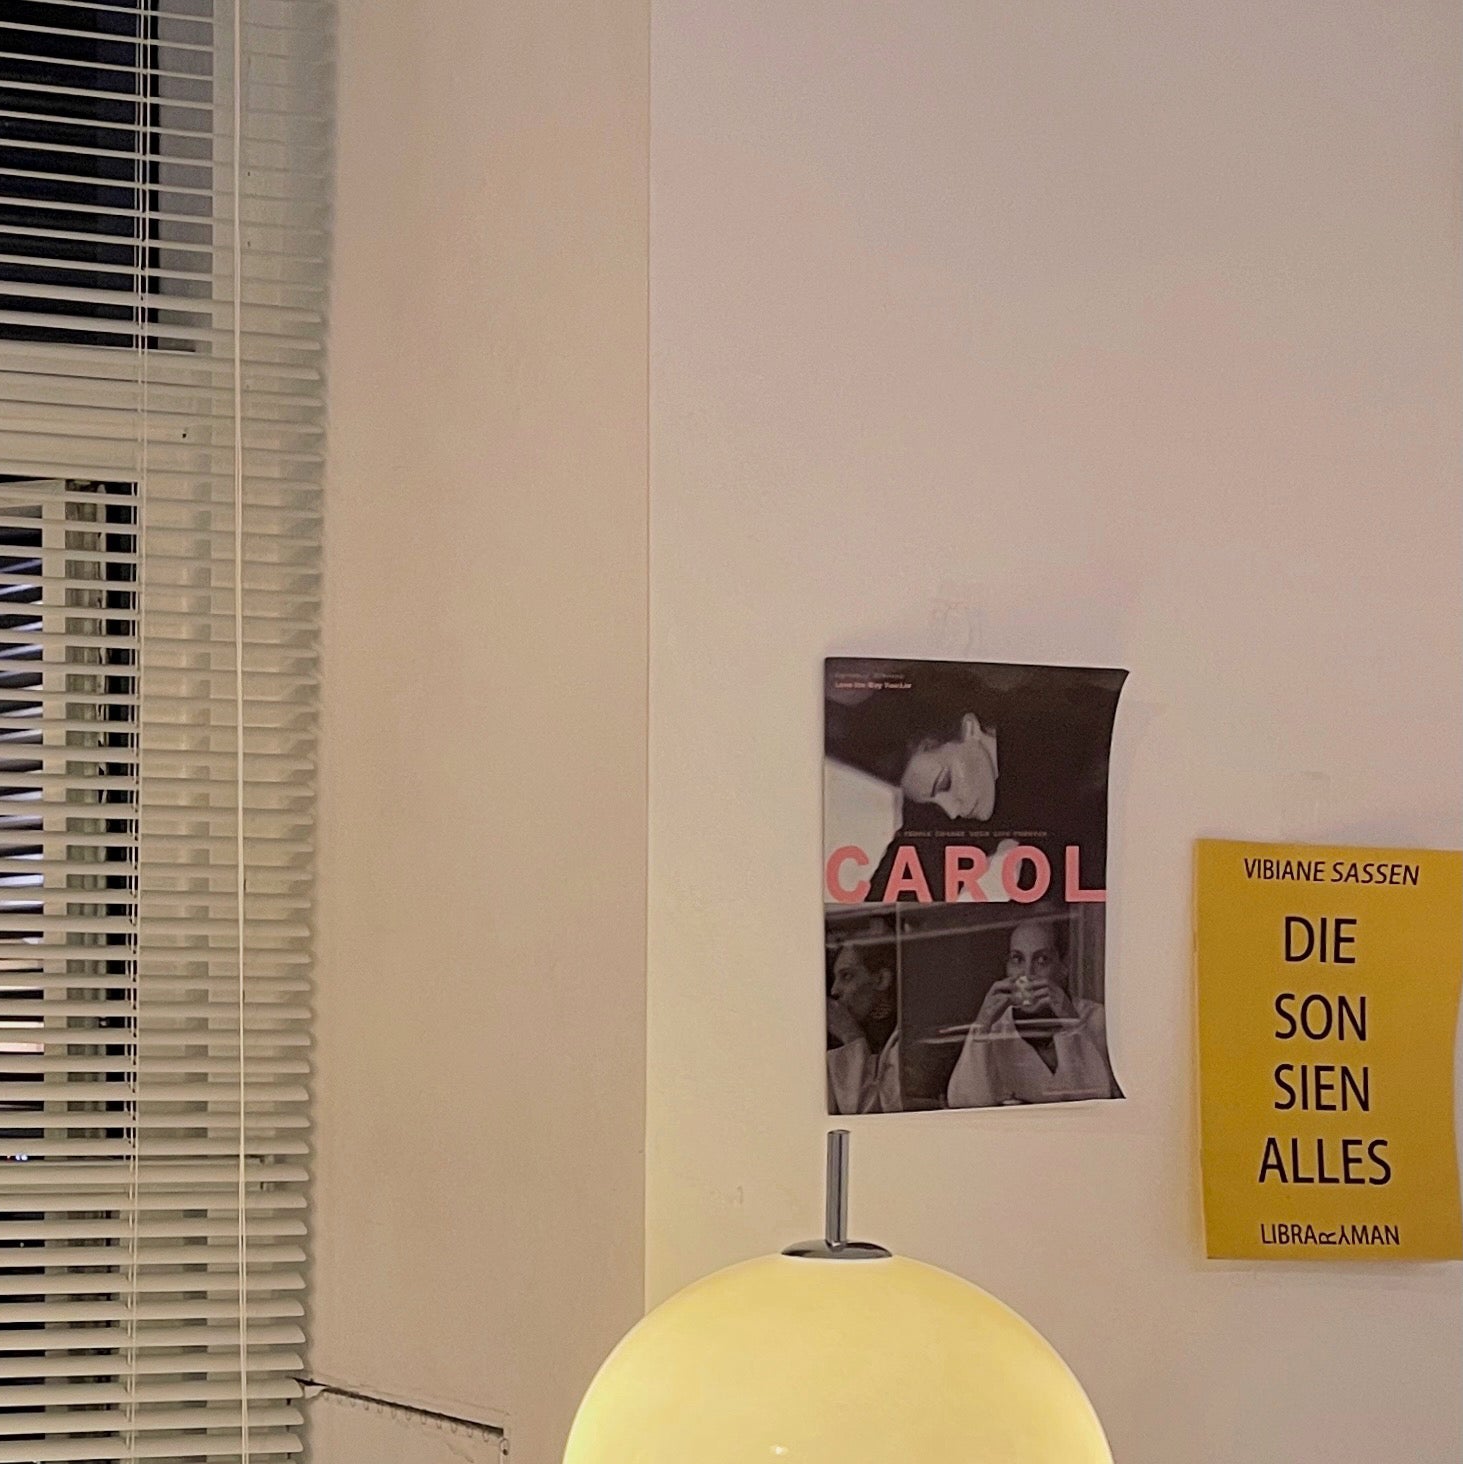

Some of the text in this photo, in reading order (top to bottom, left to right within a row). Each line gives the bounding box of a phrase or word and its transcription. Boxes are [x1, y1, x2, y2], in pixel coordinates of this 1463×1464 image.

[825, 845, 1106, 904] CAROL
[1243, 858, 1420, 886] VIBIANE SASSEN
[1284, 916, 1358, 964] DIE
[1274, 992, 1367, 1042] SON
[1274, 1063, 1370, 1112] SIEN
[1258, 1137, 1392, 1186] ALLES
